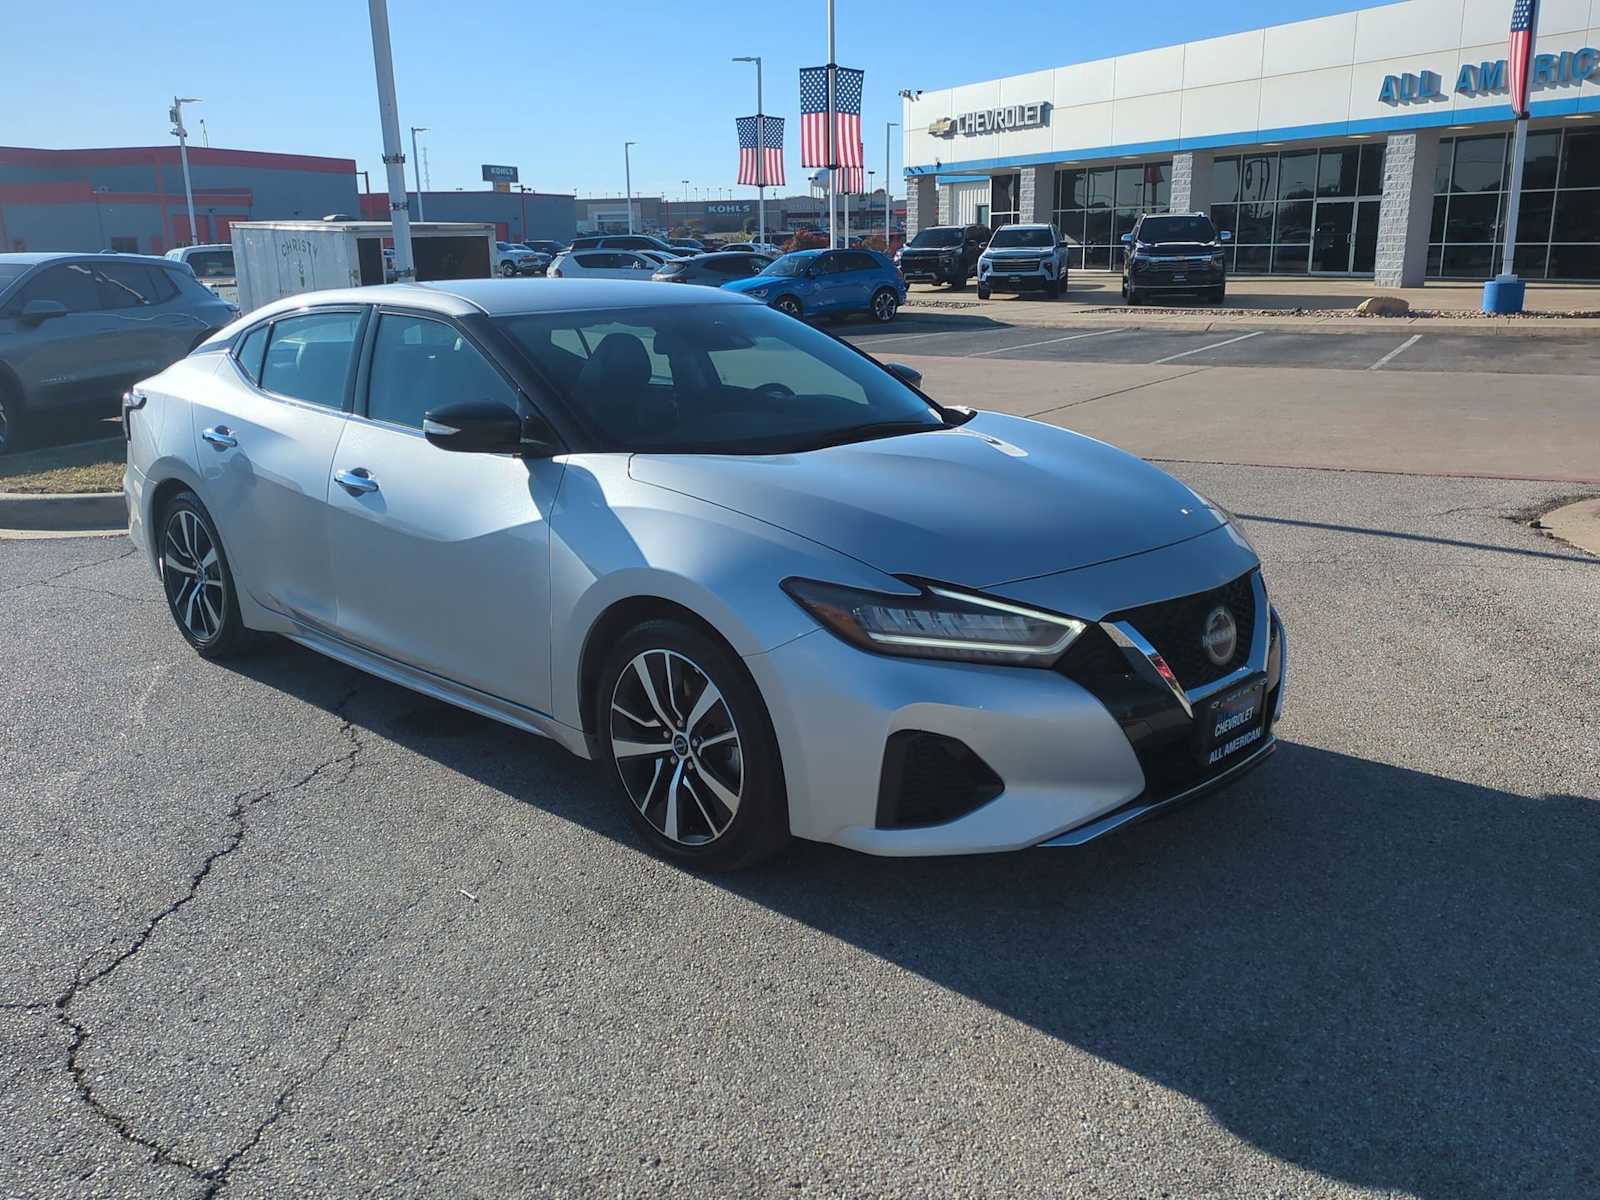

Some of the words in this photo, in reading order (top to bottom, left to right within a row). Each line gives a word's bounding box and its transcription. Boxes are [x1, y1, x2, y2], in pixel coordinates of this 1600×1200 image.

[1378, 69, 1441, 103] ALL
[1454, 47, 1600, 94] AMRIC
[957, 103, 1044, 135] CHEVROLET
[281, 239, 319, 258] CHRISTY
[1214, 706, 1255, 738] CHEVROLET
[1209, 746, 1224, 764] ALL
[1224, 727, 1262, 757] AMERICAN
